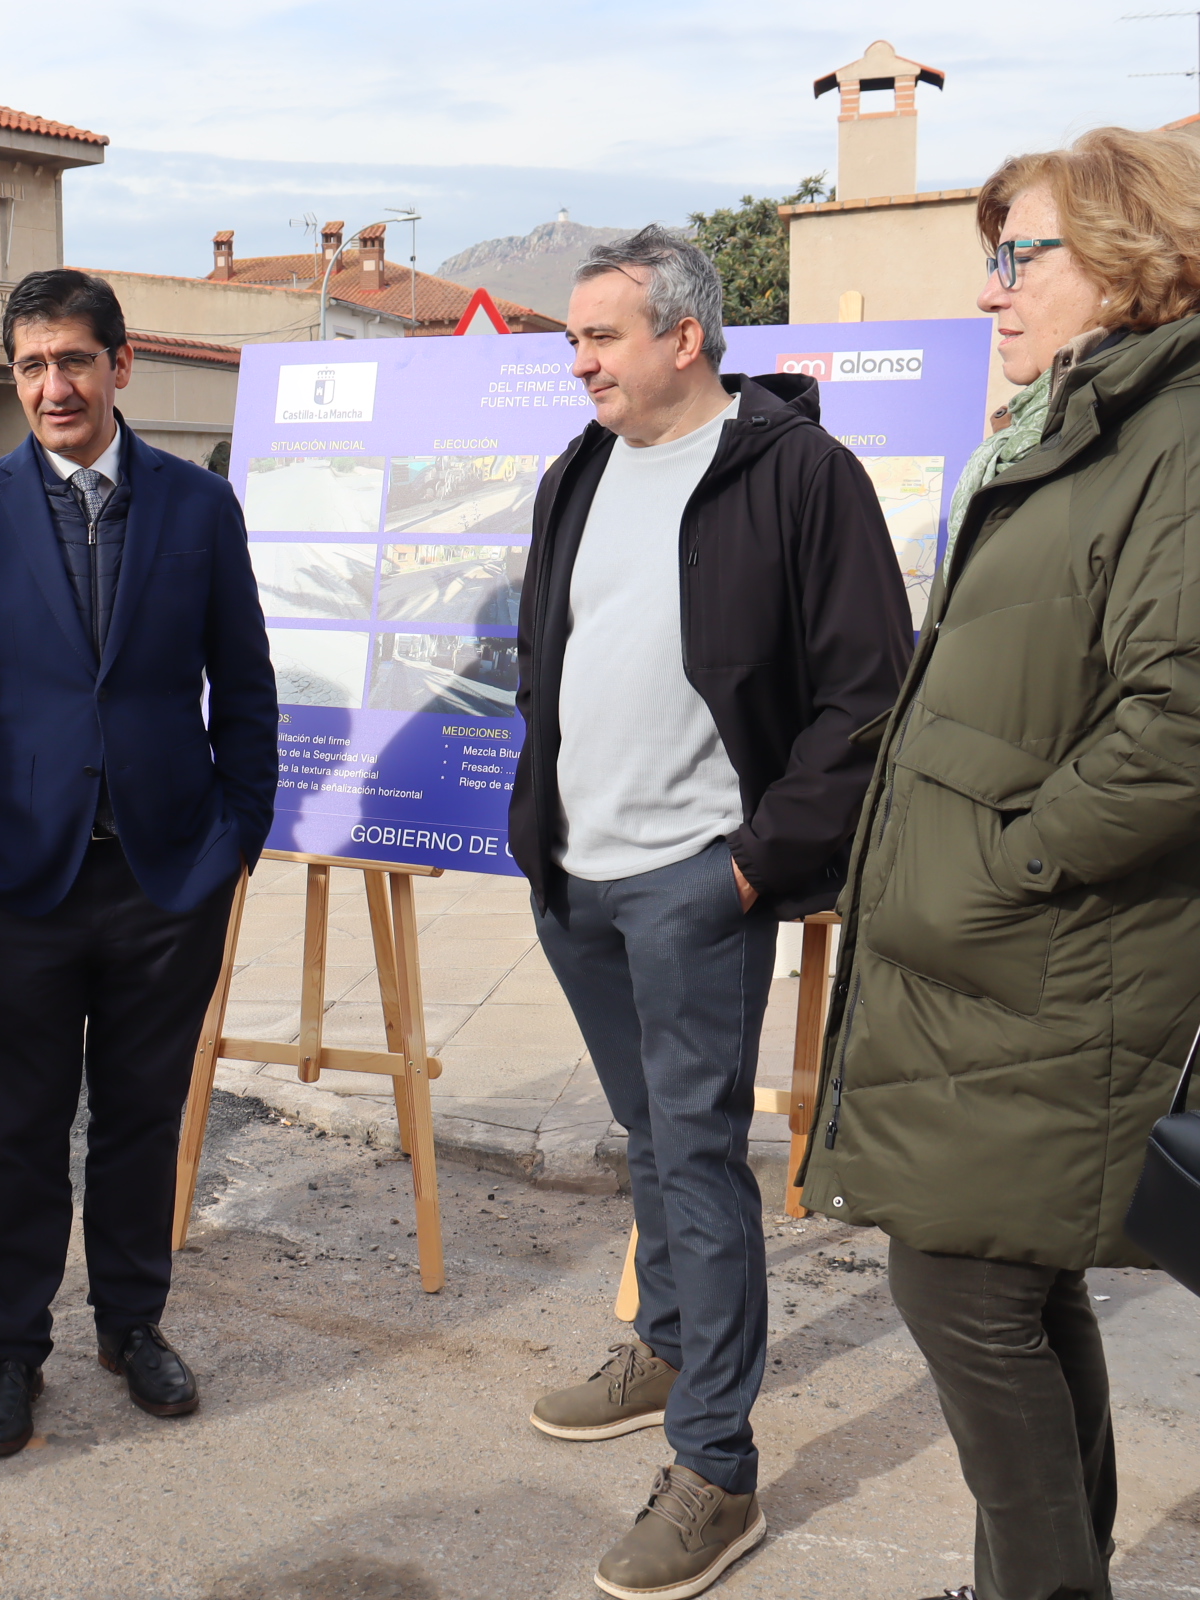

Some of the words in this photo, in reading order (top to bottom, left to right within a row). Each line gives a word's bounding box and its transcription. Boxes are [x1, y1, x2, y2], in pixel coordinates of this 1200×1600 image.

[500, 363, 561, 375] FRESADO
[564, 363, 573, 374] Y
[840, 352, 922, 373] alonso
[489, 382, 512, 393] DEL
[516, 381, 555, 392] FIRME
[558, 380, 577, 391] EN
[480, 396, 530, 408] FUENTE
[533, 396, 549, 407] EL
[270, 439, 326, 451] SITUACIÓN
[329, 440, 366, 450] INICIAL
[434, 437, 498, 449] EJECUCIÓN
[442, 726, 512, 740] MEDICIONES:
[312, 734, 326, 744] del
[328, 736, 351, 746] firme
[289, 748, 300, 758] de
[302, 749, 311, 758] la
[313, 750, 358, 762] Seguridad
[361, 754, 378, 764] Vial
[463, 746, 496, 757] Mezcla
[278, 763, 288, 772] de
[290, 764, 299, 773] la
[301, 765, 331, 776] textura
[334, 768, 380, 780] superficial
[461, 762, 504, 774] Fresado:
[297, 780, 308, 790] de
[310, 781, 319, 791] la
[320, 783, 376, 796] señalización
[378, 786, 423, 800] horizontal
[459, 777, 487, 790] Riego
[489, 780, 502, 790] de
[350, 824, 463, 852] GOBIERNO
[469, 836, 498, 856] DE
